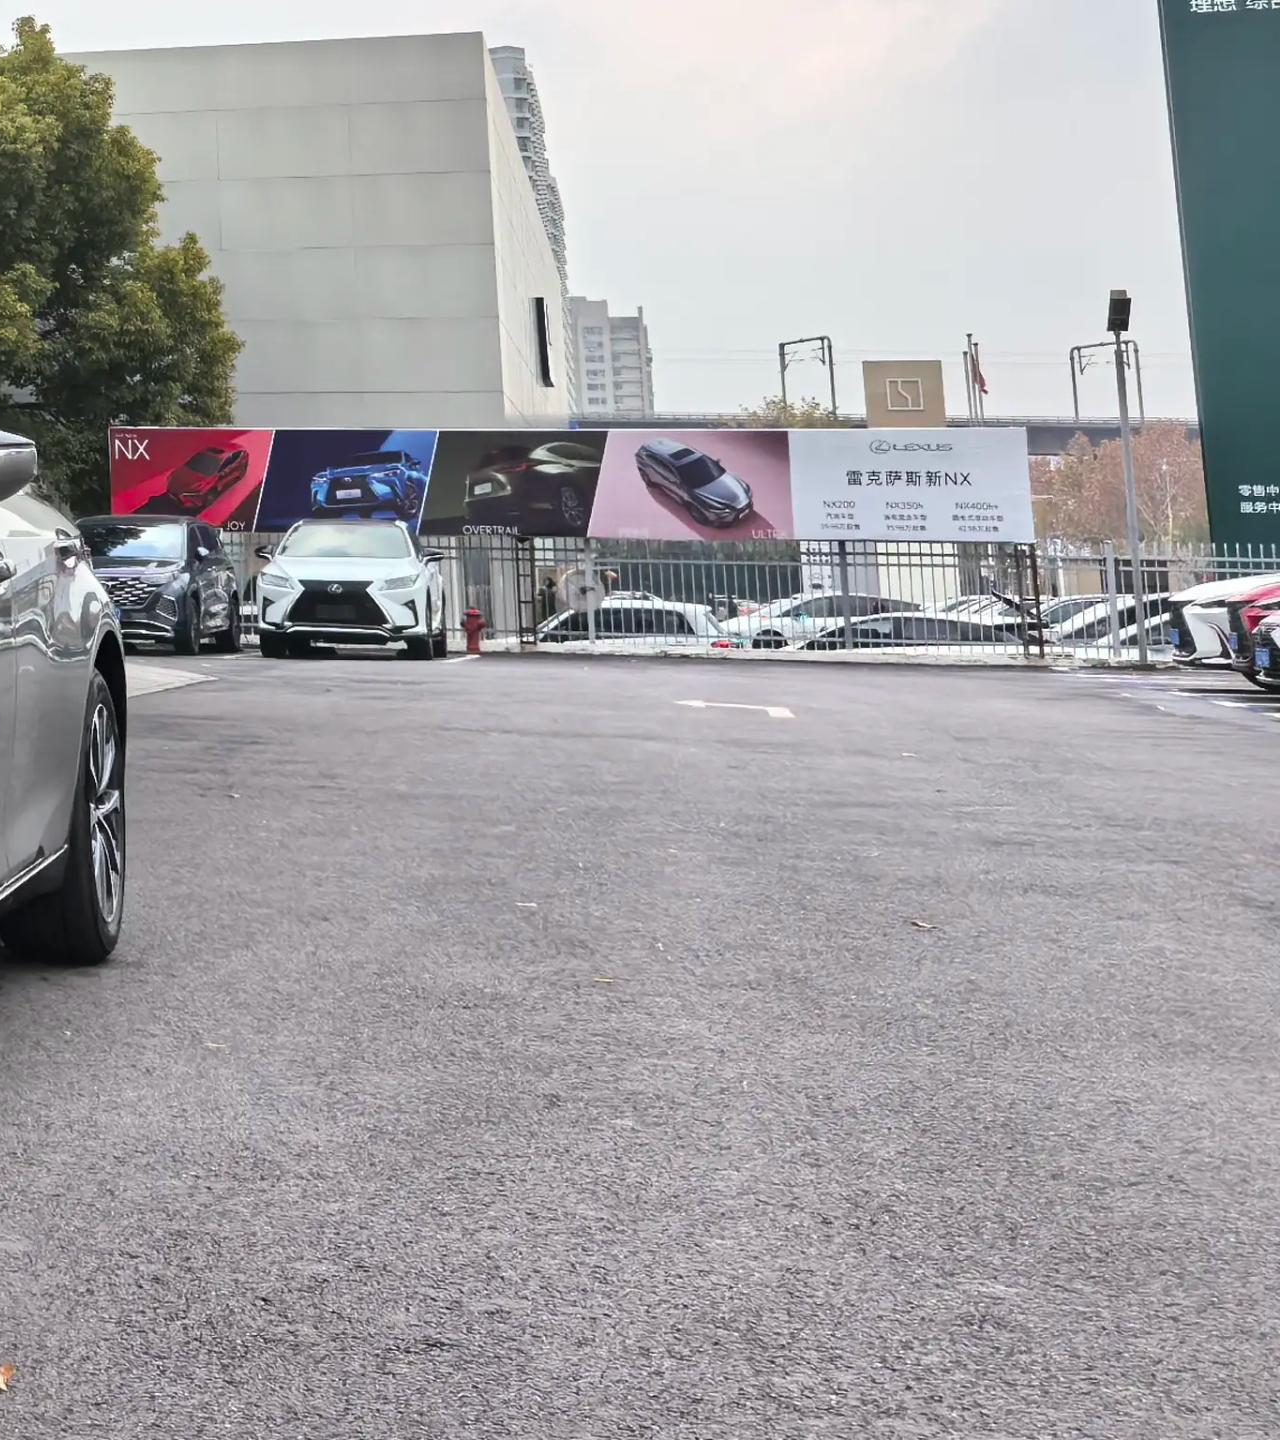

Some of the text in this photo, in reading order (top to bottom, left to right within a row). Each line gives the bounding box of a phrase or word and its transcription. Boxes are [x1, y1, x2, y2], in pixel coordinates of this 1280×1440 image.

[114, 439, 151, 461] NX
[892, 442, 953, 453] LEXUS
[846, 470, 973, 488] 雷克萨斯新NX
[462, 524, 521, 536] OVERTRAIL
